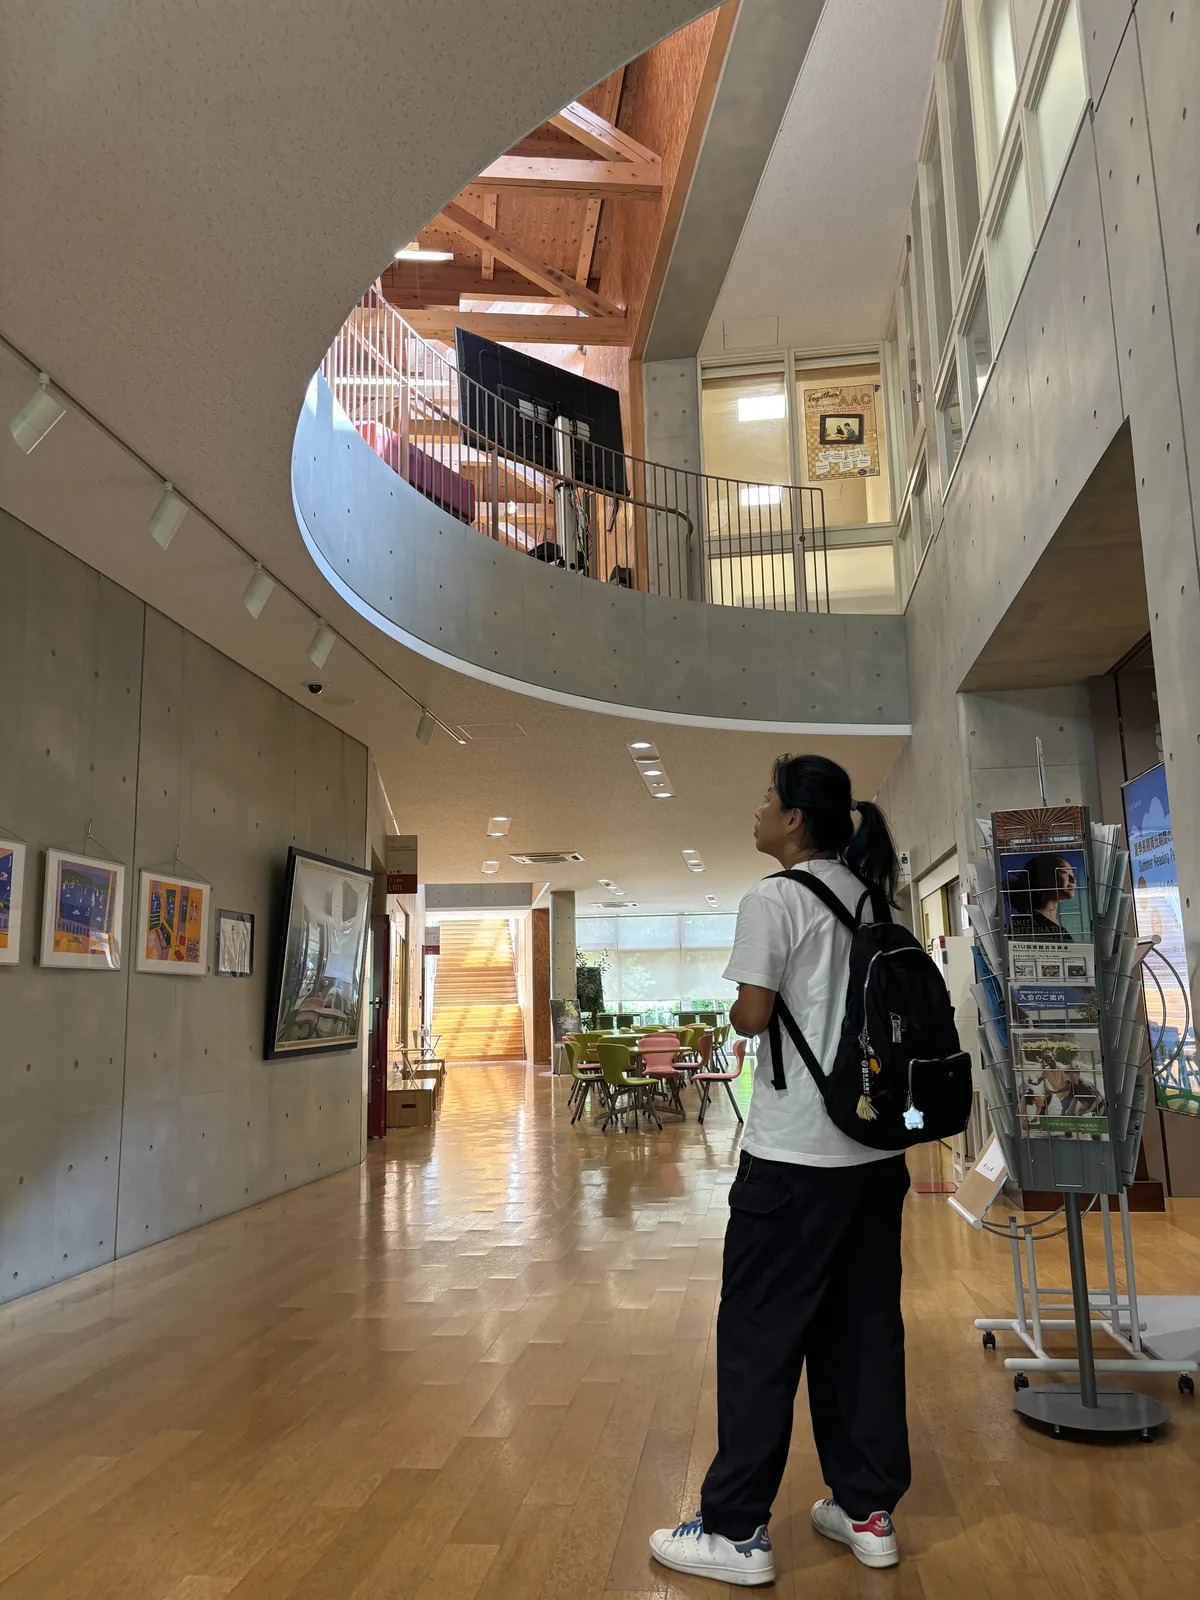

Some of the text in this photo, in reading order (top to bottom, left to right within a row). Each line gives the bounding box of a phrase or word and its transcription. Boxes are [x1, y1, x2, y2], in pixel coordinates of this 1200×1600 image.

[838, 393, 872, 407] AAC
[1138, 858, 1154, 873] Summer
[1153, 851, 1170, 868] Reading
[388, 884, 402, 892] L101
[1012, 919, 1038, 927] AKITA
